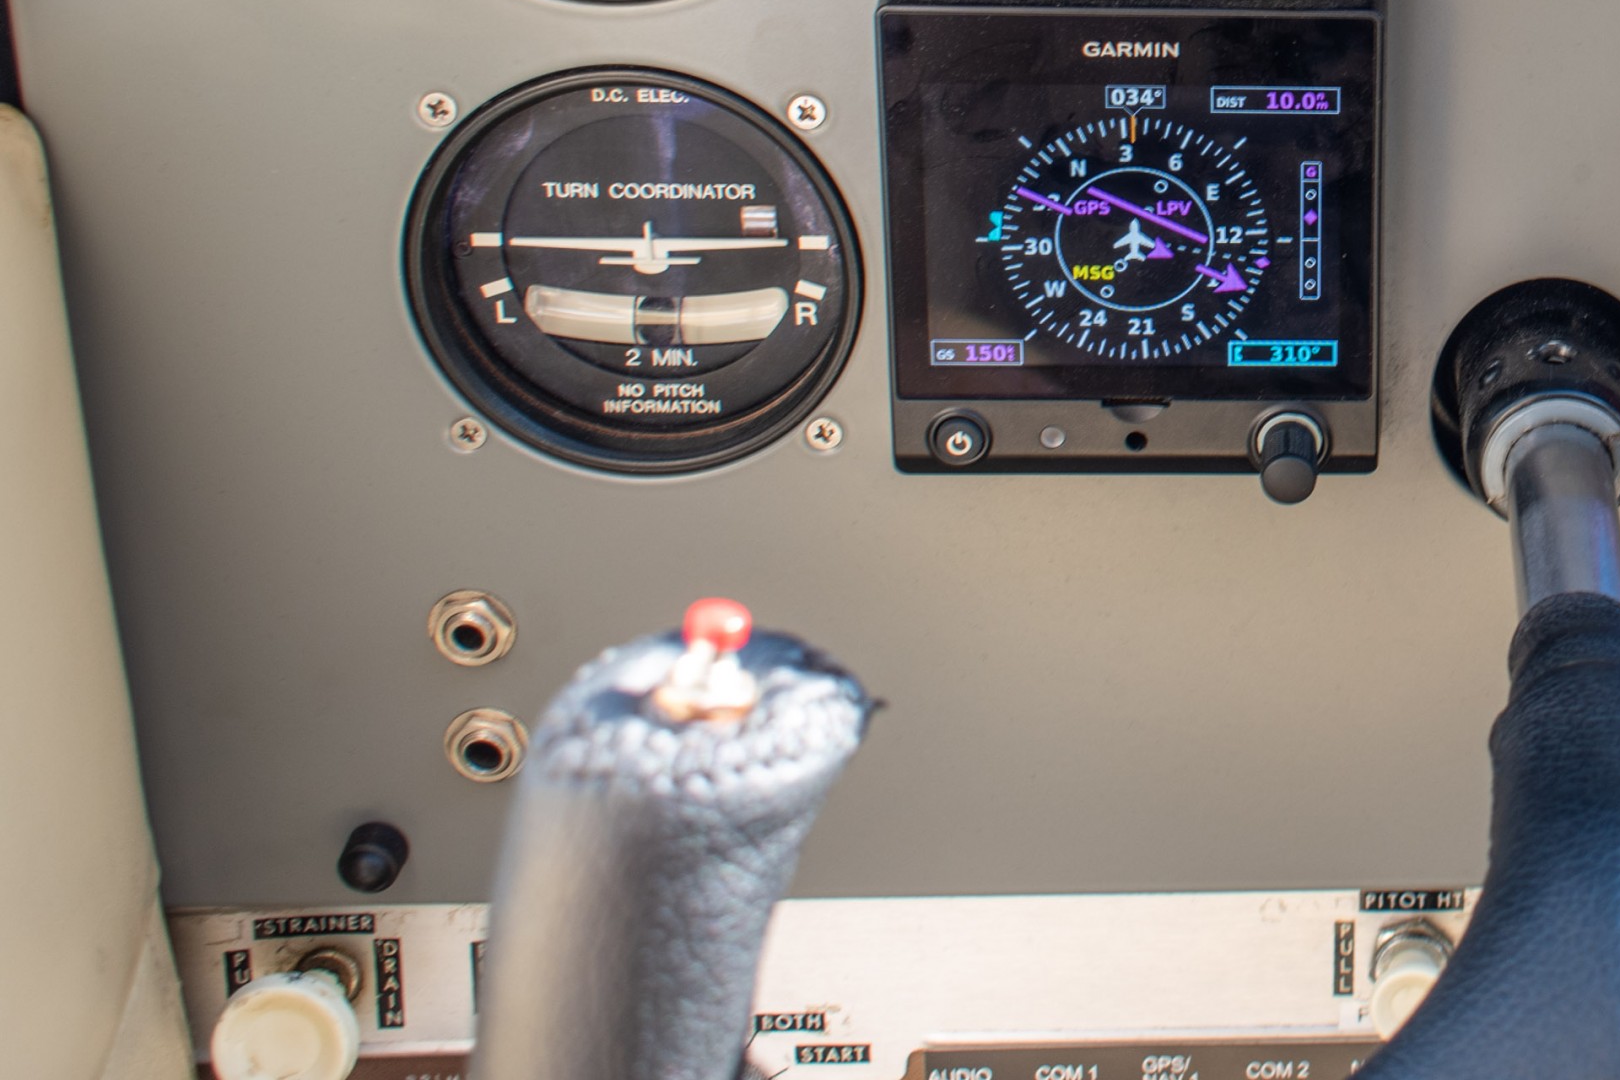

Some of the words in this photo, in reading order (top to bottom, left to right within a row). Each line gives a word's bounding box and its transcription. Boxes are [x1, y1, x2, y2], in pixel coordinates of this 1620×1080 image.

[1082, 41, 1181, 58] GARMIN
[591, 88, 628, 104] D.C.
[1215, 95, 1247, 109] DIST
[541, 181, 599, 199] TURN
[608, 182, 756, 200] COORDINATOR
[1073, 201, 1111, 216] GPS
[1156, 201, 1192, 216] LPV
[1216, 227, 1244, 245] 12
[1024, 238, 1053, 256] 30
[1073, 265, 1115, 281] MSG
[1043, 281, 1067, 298] W
[496, 300, 518, 324] L
[794, 302, 818, 326] R
[1079, 310, 1107, 327] 24
[1127, 319, 1156, 335] 21
[624, 349, 641, 367] 2
[651, 349, 699, 368] MIN.
[617, 383, 645, 398] NO
[653, 383, 705, 398] PITCH
[603, 399, 721, 415] INFORMATION
[1365, 893, 1427, 910] PITOT
[1437, 893, 1463, 908] HT
[263, 914, 373, 936] STRAINER
[800, 1046, 866, 1063] START
[1245, 1061, 1293, 1080] COM
[1297, 1061, 1310, 1079] 2
